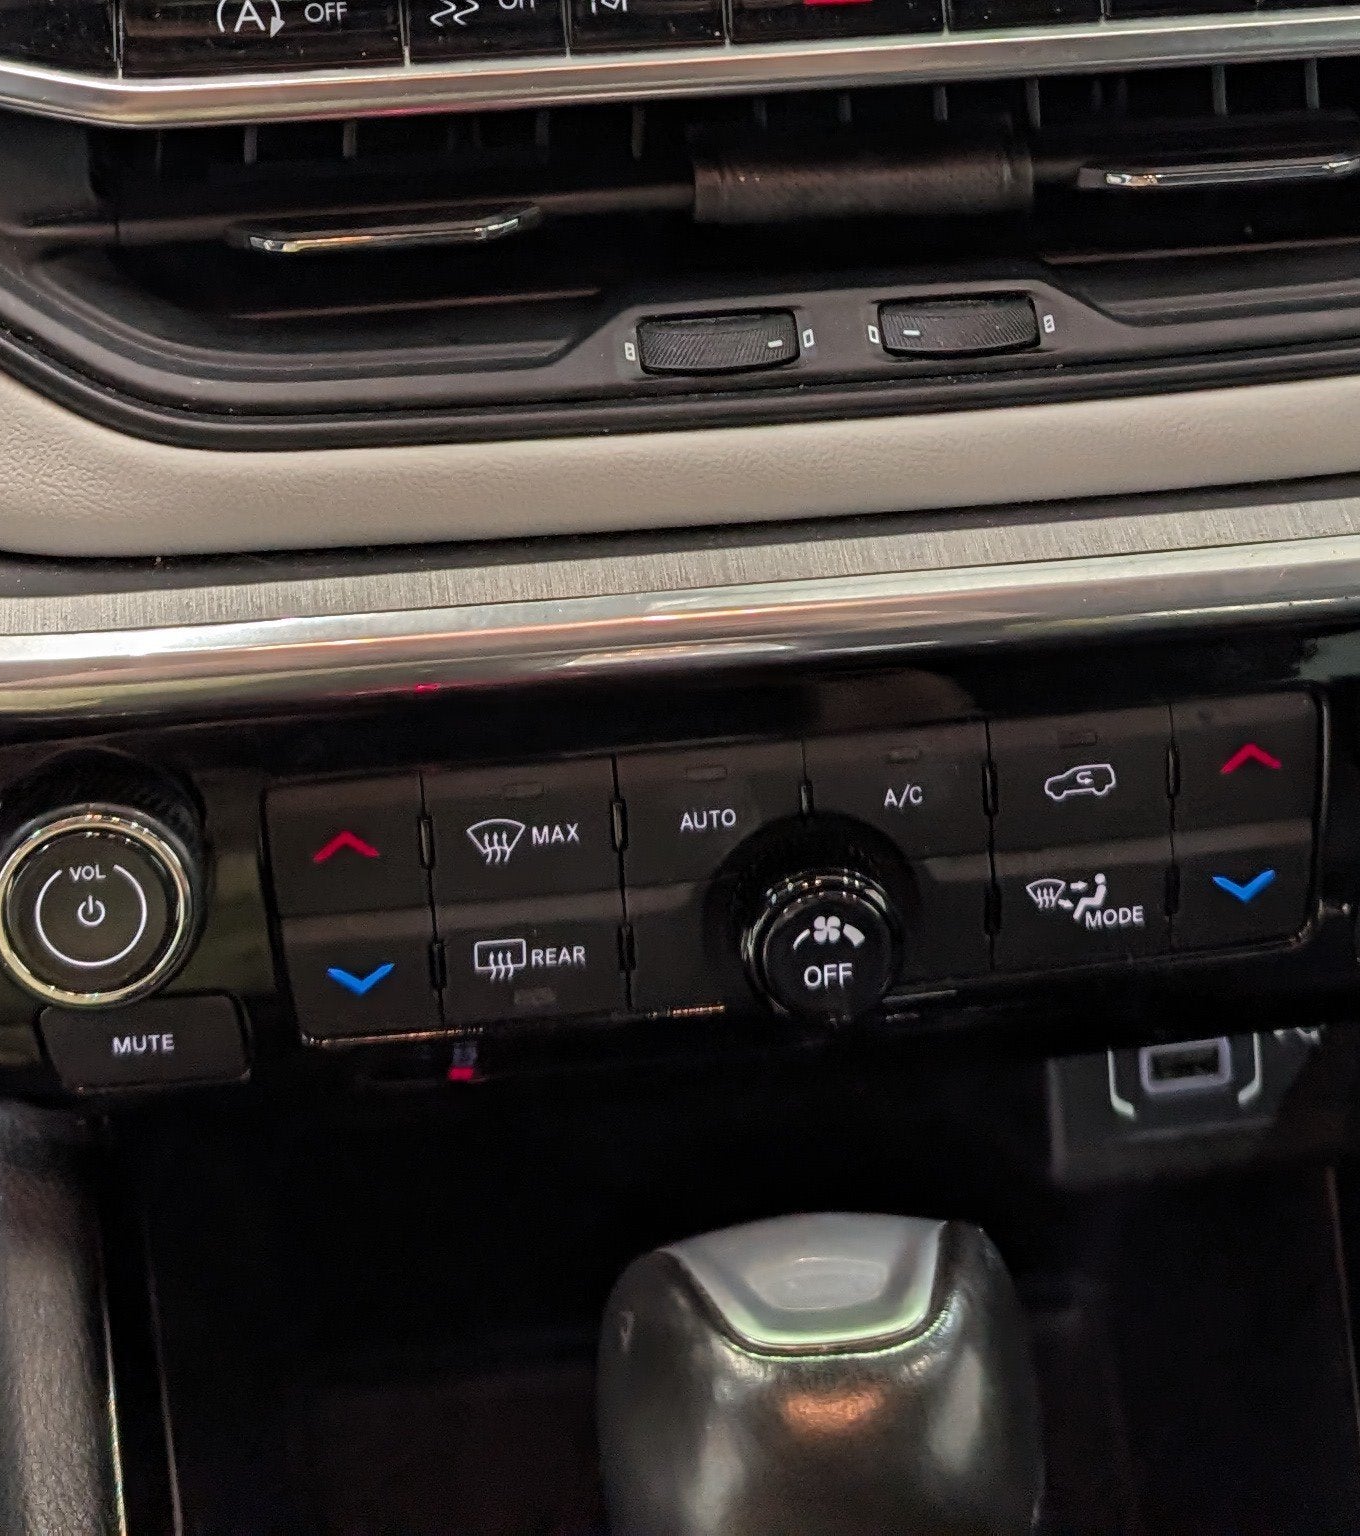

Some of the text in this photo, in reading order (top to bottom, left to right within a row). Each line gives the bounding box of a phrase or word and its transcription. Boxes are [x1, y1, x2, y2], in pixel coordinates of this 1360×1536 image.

[305, 2, 347, 22] OFF
[884, 784, 922, 807] A/C
[681, 809, 736, 830] AUTO
[532, 823, 578, 844] MAX
[69, 865, 106, 881] VOL
[1084, 903, 1144, 929] MODE
[532, 946, 585, 966] REAR
[804, 963, 852, 987] OFF
[113, 1034, 174, 1053] MUTE
